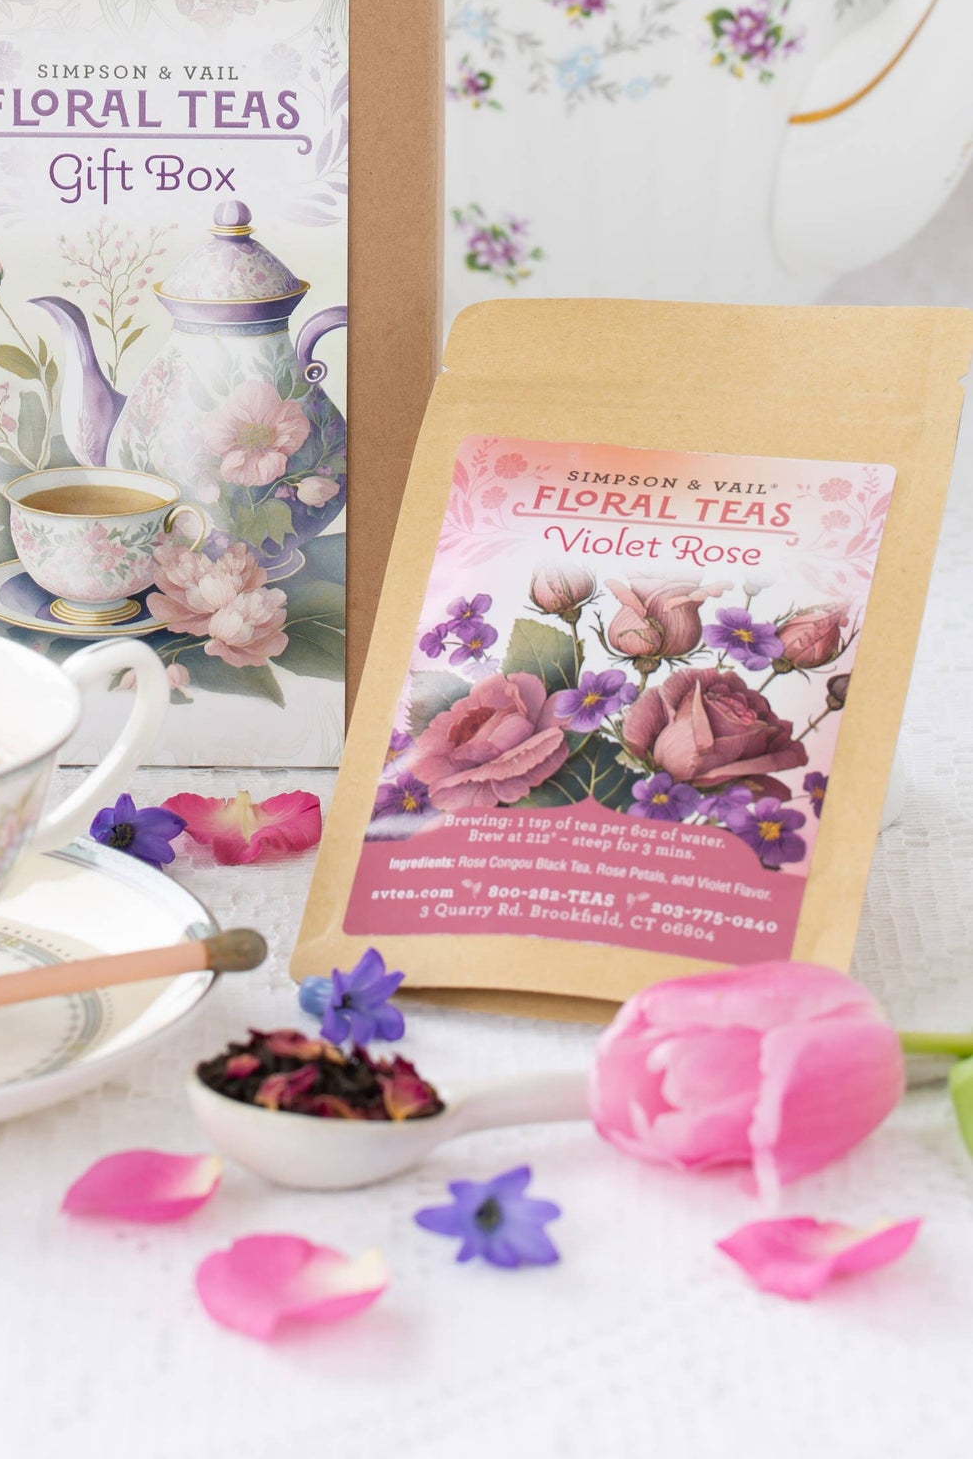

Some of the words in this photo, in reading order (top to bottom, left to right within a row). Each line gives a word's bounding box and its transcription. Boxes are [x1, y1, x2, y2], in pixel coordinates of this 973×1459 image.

[37, 64, 147, 79] SIMPSON
[158, 66, 172, 80] &
[178, 90, 300, 130] TEAS
[49, 147, 133, 205] Gift
[145, 155, 235, 192] Box
[567, 470, 678, 489] SIMPSON
[687, 479, 701, 490] &
[532, 485, 677, 520] FLORAL
[695, 498, 792, 528] TEAS
[544, 526, 663, 559] Violet
[672, 535, 761, 567] Rose
[444, 814, 512, 830] Brewing:
[518, 817, 524, 827] 1
[529, 817, 551, 831] tsp
[556, 816, 572, 830] of
[575, 820, 597, 833] tea
[601, 823, 627, 836] per
[631, 824, 657, 839] 6oz
[661, 828, 677, 841] of
[681, 832, 726, 849] water.
[468, 829, 504, 843] Brew
[507, 831, 521, 843] at
[572, 836, 612, 852] steep
[616, 837, 638, 853] for
[641, 842, 651, 856] 3
[655, 844, 696, 860] mins.
[389, 857, 455, 871] Ingredients:
[458, 856, 487, 868] Rose
[489, 856, 532, 870] Congou
[536, 857, 567, 871] Black
[596, 863, 626, 878] Rose
[671, 873, 694, 887] and
[697, 876, 731, 894] Violet
[734, 882, 772, 901] Flavor.
[371, 888, 454, 900] svtea.com
[488, 885, 614, 907] 800-282-TEAS
[651, 902, 778, 934] 203-775-0240
[419, 904, 429, 919] 3
[434, 903, 492, 918] Quarry
[497, 904, 523, 917] Rd.
[530, 905, 624, 929] Brookfield,
[630, 916, 656, 931] CT
[661, 922, 715, 942] 06804
